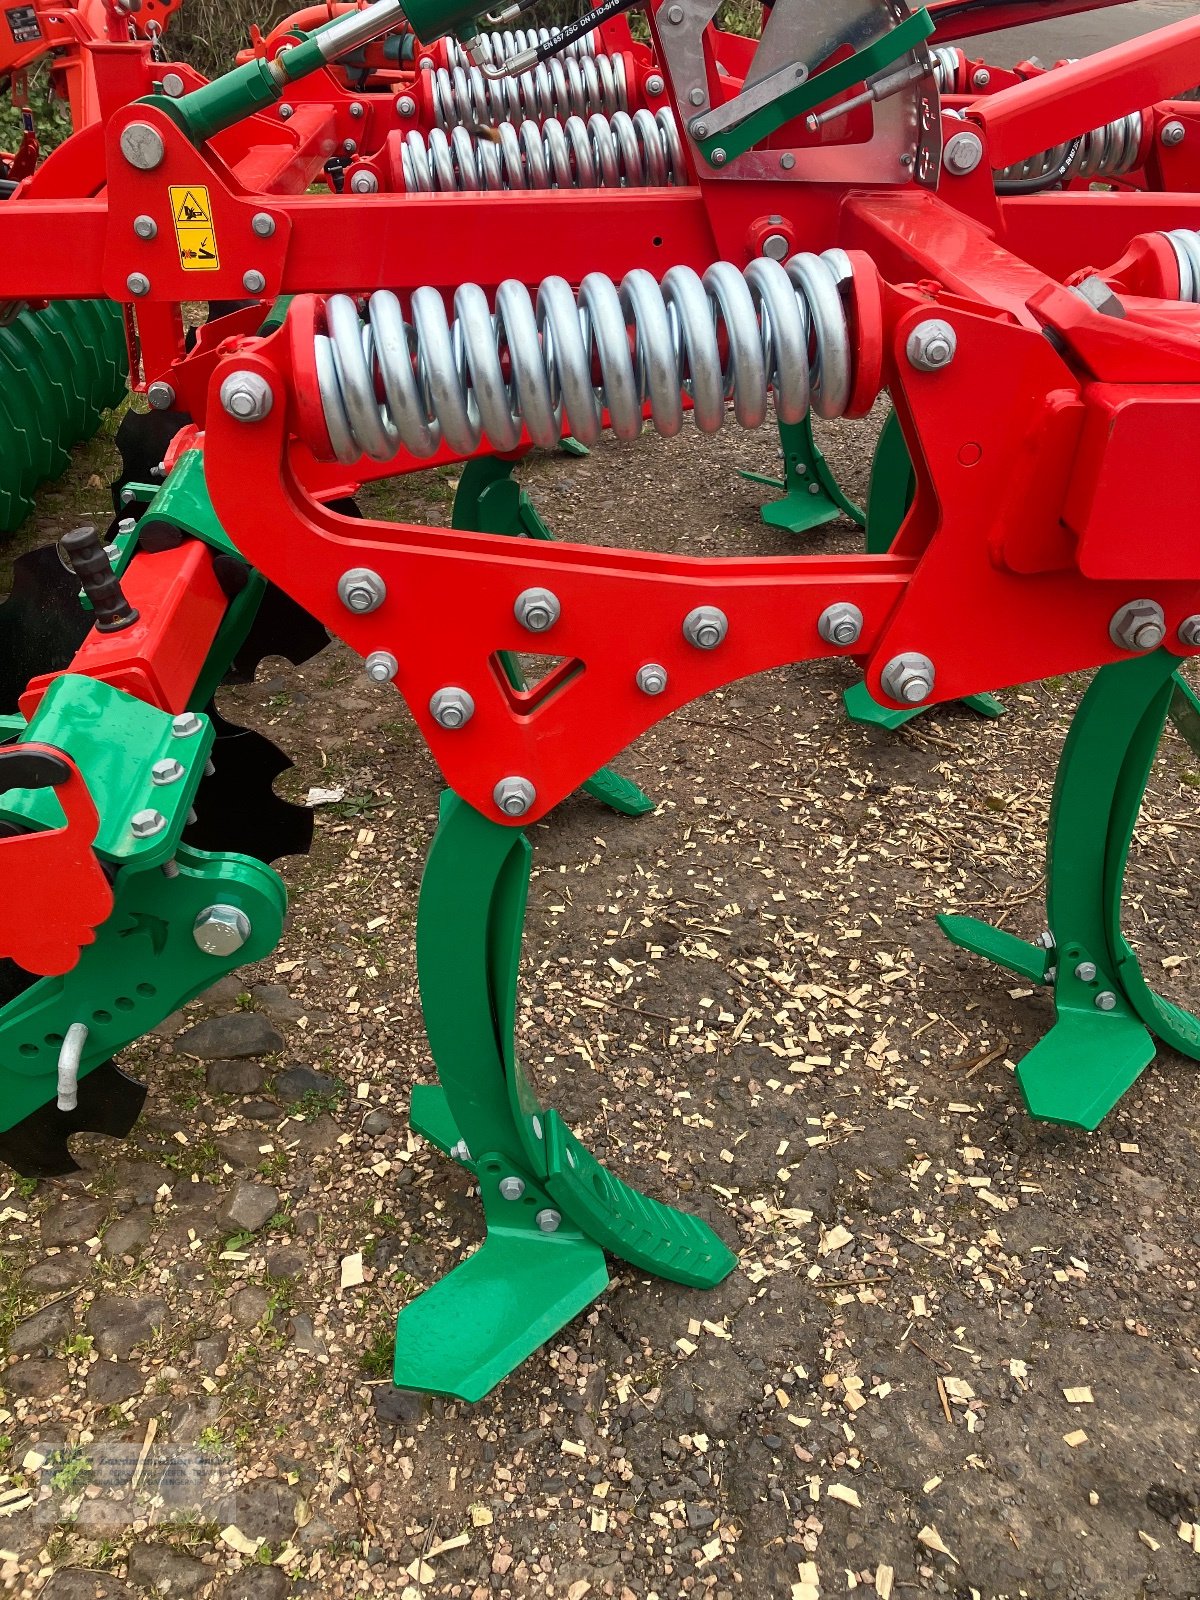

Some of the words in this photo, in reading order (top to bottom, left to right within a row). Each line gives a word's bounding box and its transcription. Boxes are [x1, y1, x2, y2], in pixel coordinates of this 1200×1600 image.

[543, 41, 554, 51] EN
[553, 33, 564, 44] 857
[565, 25, 578, 36] 2SC
[580, 15, 591, 27] DN
